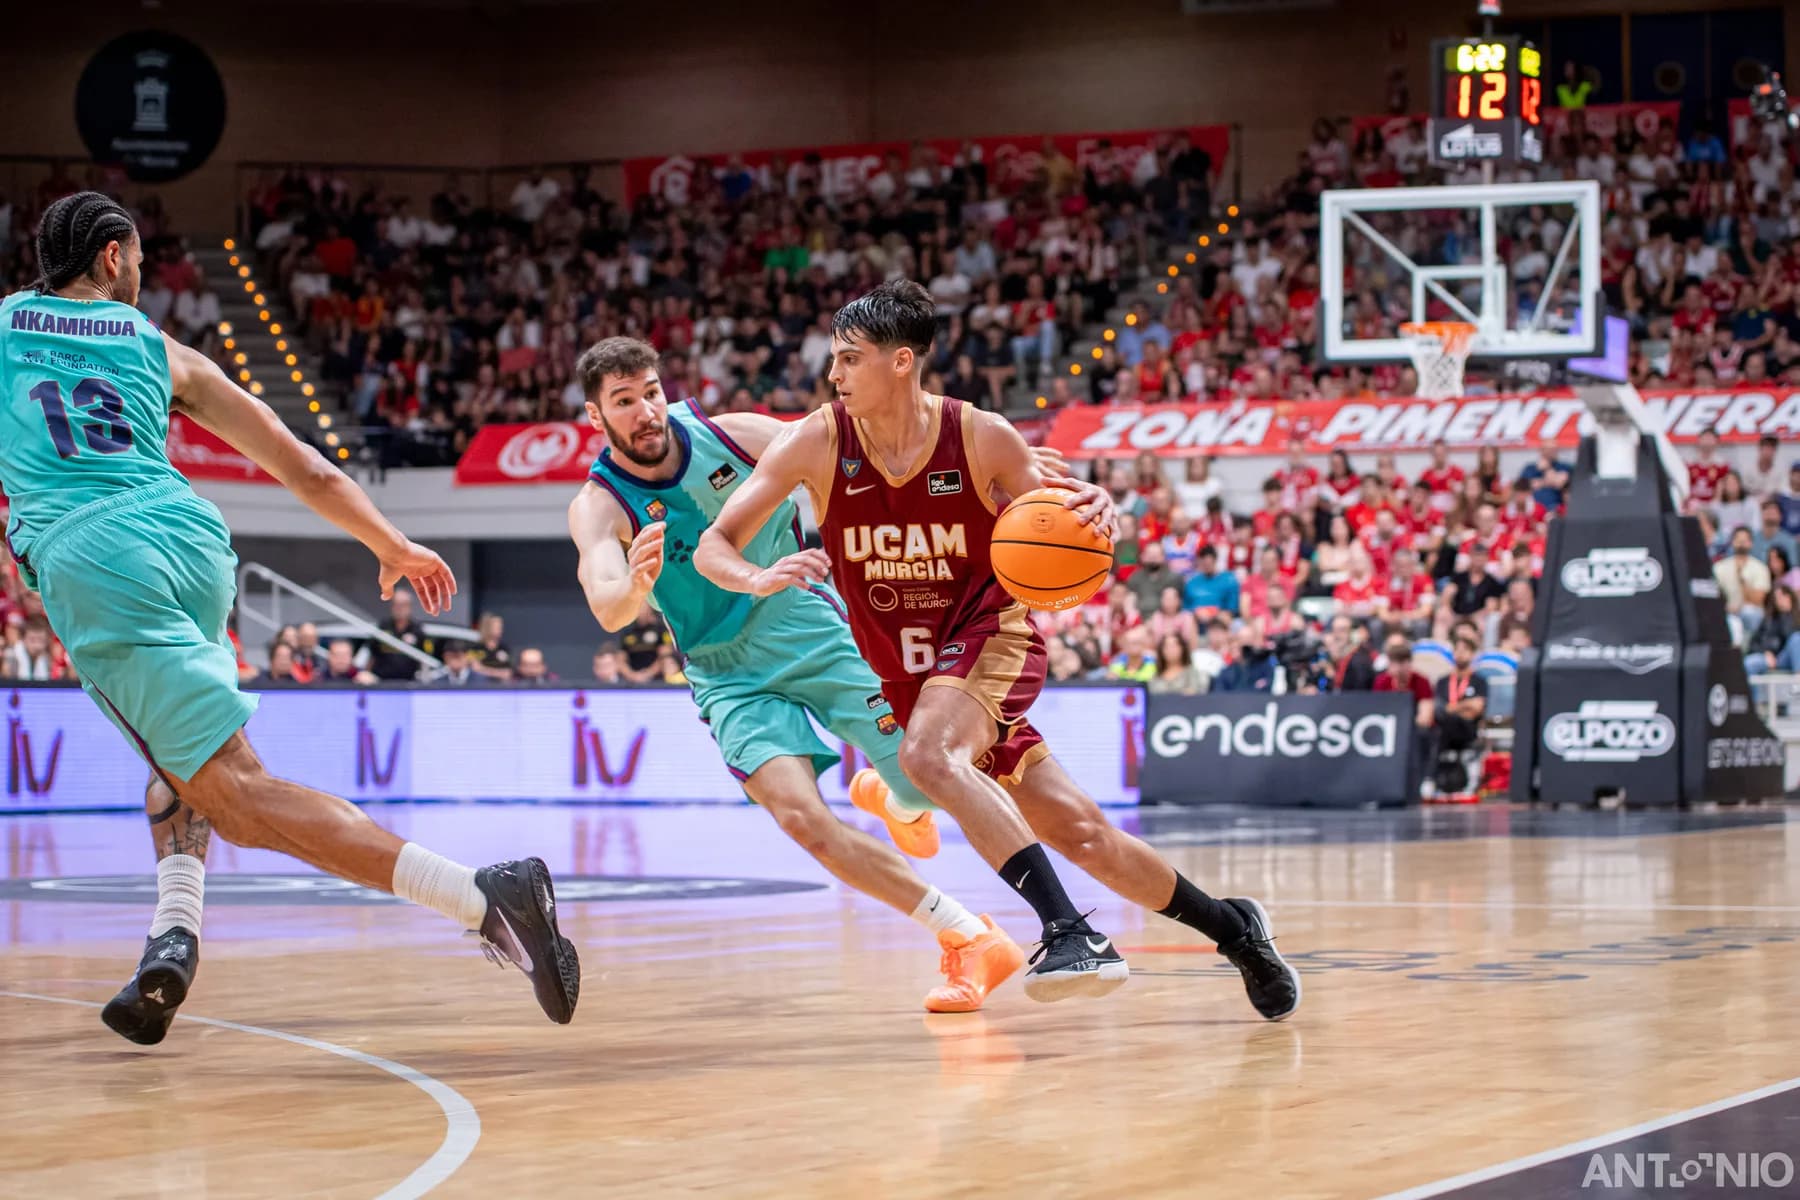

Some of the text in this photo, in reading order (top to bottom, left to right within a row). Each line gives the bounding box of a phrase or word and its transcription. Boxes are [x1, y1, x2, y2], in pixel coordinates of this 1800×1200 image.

[1459, 72, 1507, 120] 12
[11, 309, 137, 338] NKAMHOUA
[50, 357, 120, 376] FOUNDATION
[29, 377, 134, 460] 13
[1081, 405, 1274, 449] ZONA
[843, 523, 969, 563] UCAM
[864, 558, 955, 581] MURCIA
[903, 590, 939, 601] REGIÓN
[904, 598, 955, 610] DE MURCIA
[900, 626, 937, 675] 6
[1150, 701, 1398, 758] endesa
